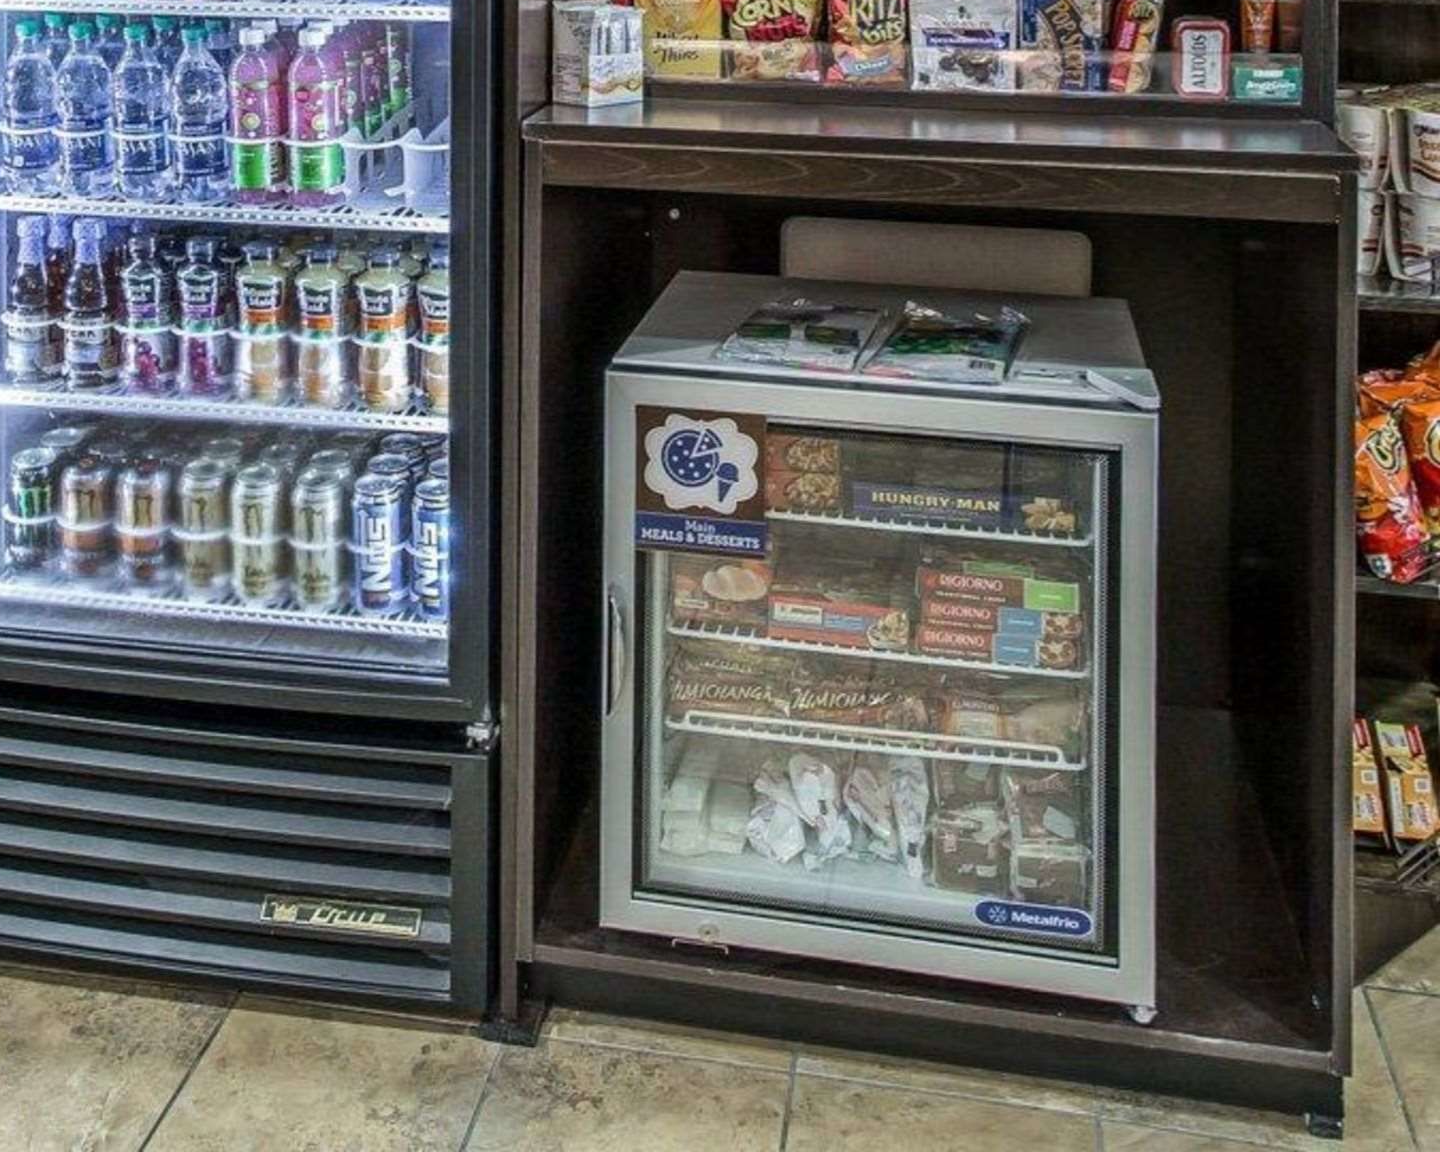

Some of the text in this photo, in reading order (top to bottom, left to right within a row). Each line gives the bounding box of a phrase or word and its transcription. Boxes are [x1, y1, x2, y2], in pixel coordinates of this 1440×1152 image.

[1191, 34, 1208, 89] ALTOIDS
[684, 519, 716, 535] Main
[641, 528, 761, 550] MEALS & DESSERTS
[1010, 910, 1080, 929] Metalfrio
